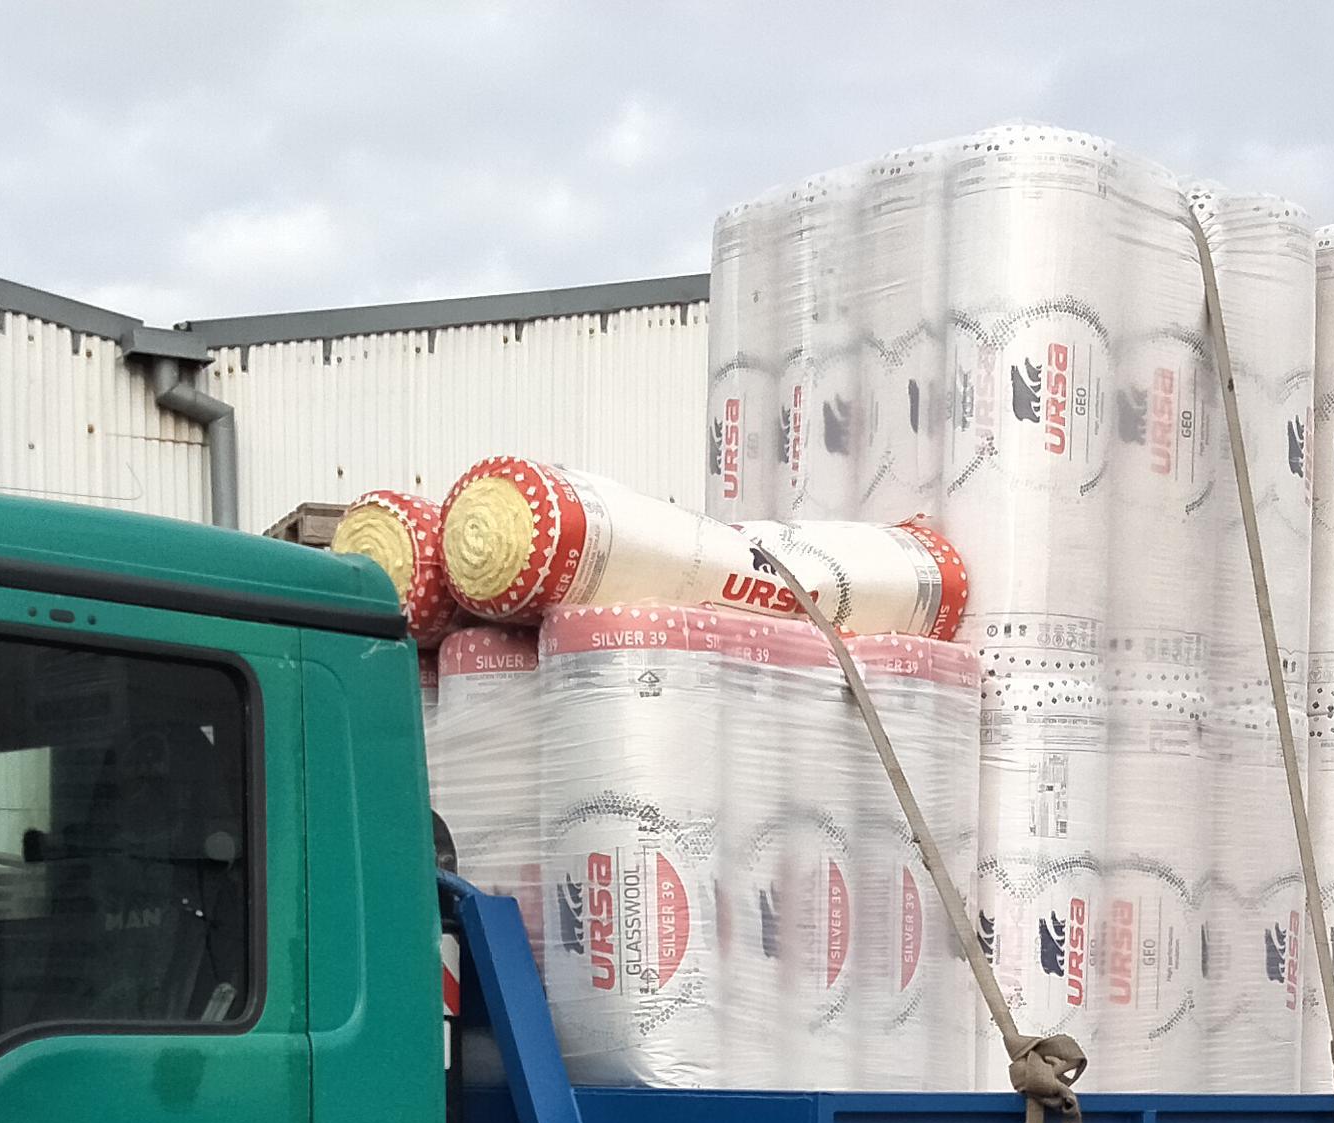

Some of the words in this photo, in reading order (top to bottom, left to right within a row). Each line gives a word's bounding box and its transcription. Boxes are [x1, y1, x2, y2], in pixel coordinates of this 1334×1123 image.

[1074, 387, 1086, 416] GEO
[1181, 411, 1192, 438] GEO
[566, 549, 579, 569] 39
[592, 631, 644, 647] SILVER
[649, 631, 667, 645] 39
[476, 655, 524, 670] SILVER
[662, 881, 675, 900] 39
[832, 886, 841, 905] 39
[906, 892, 915, 908] 39
[624, 865, 642, 976] GLASSWOOL
[661, 905, 675, 958] SILVER
[831, 910, 842, 959] SILVER
[905, 915, 914, 963] SILVER
[1143, 938, 1156, 966] GEO
